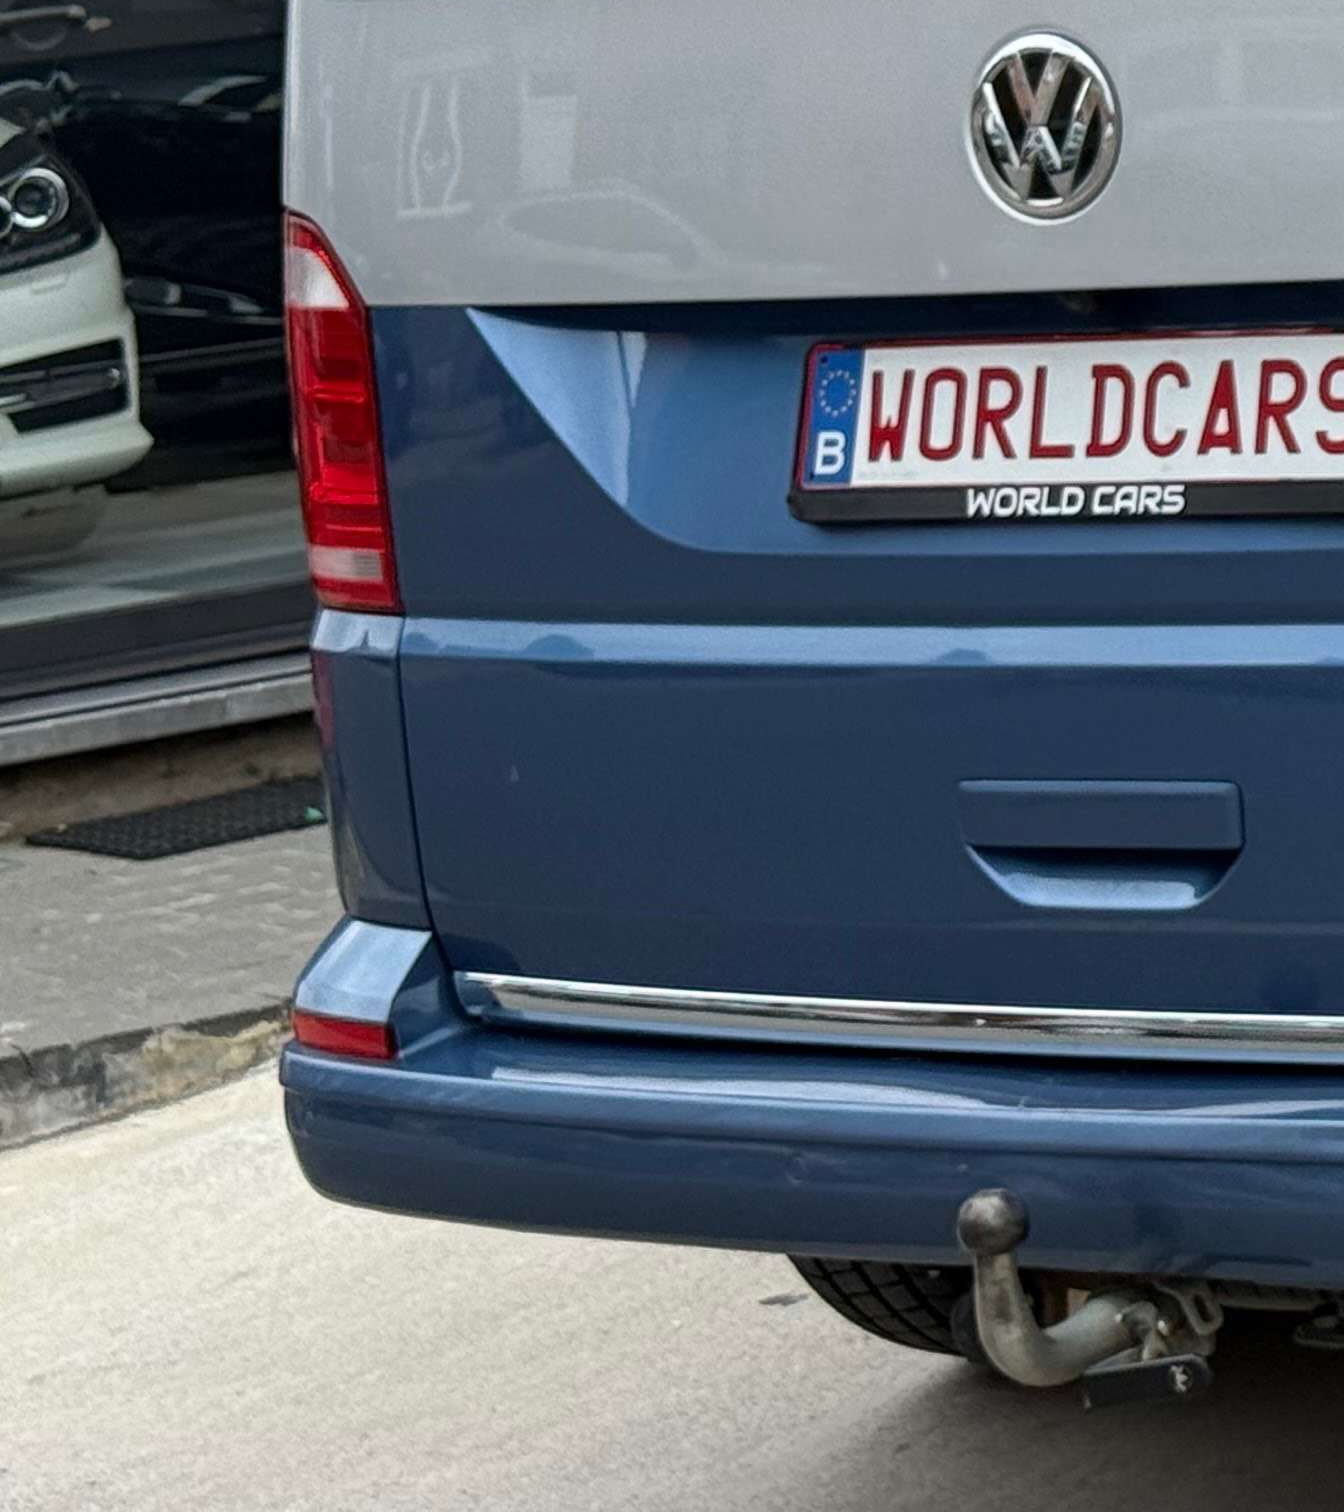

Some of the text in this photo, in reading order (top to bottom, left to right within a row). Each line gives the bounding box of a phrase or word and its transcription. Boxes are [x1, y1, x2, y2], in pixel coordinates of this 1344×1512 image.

[814, 430, 847, 475] B
[965, 484, 1187, 519] WORLD CARS
